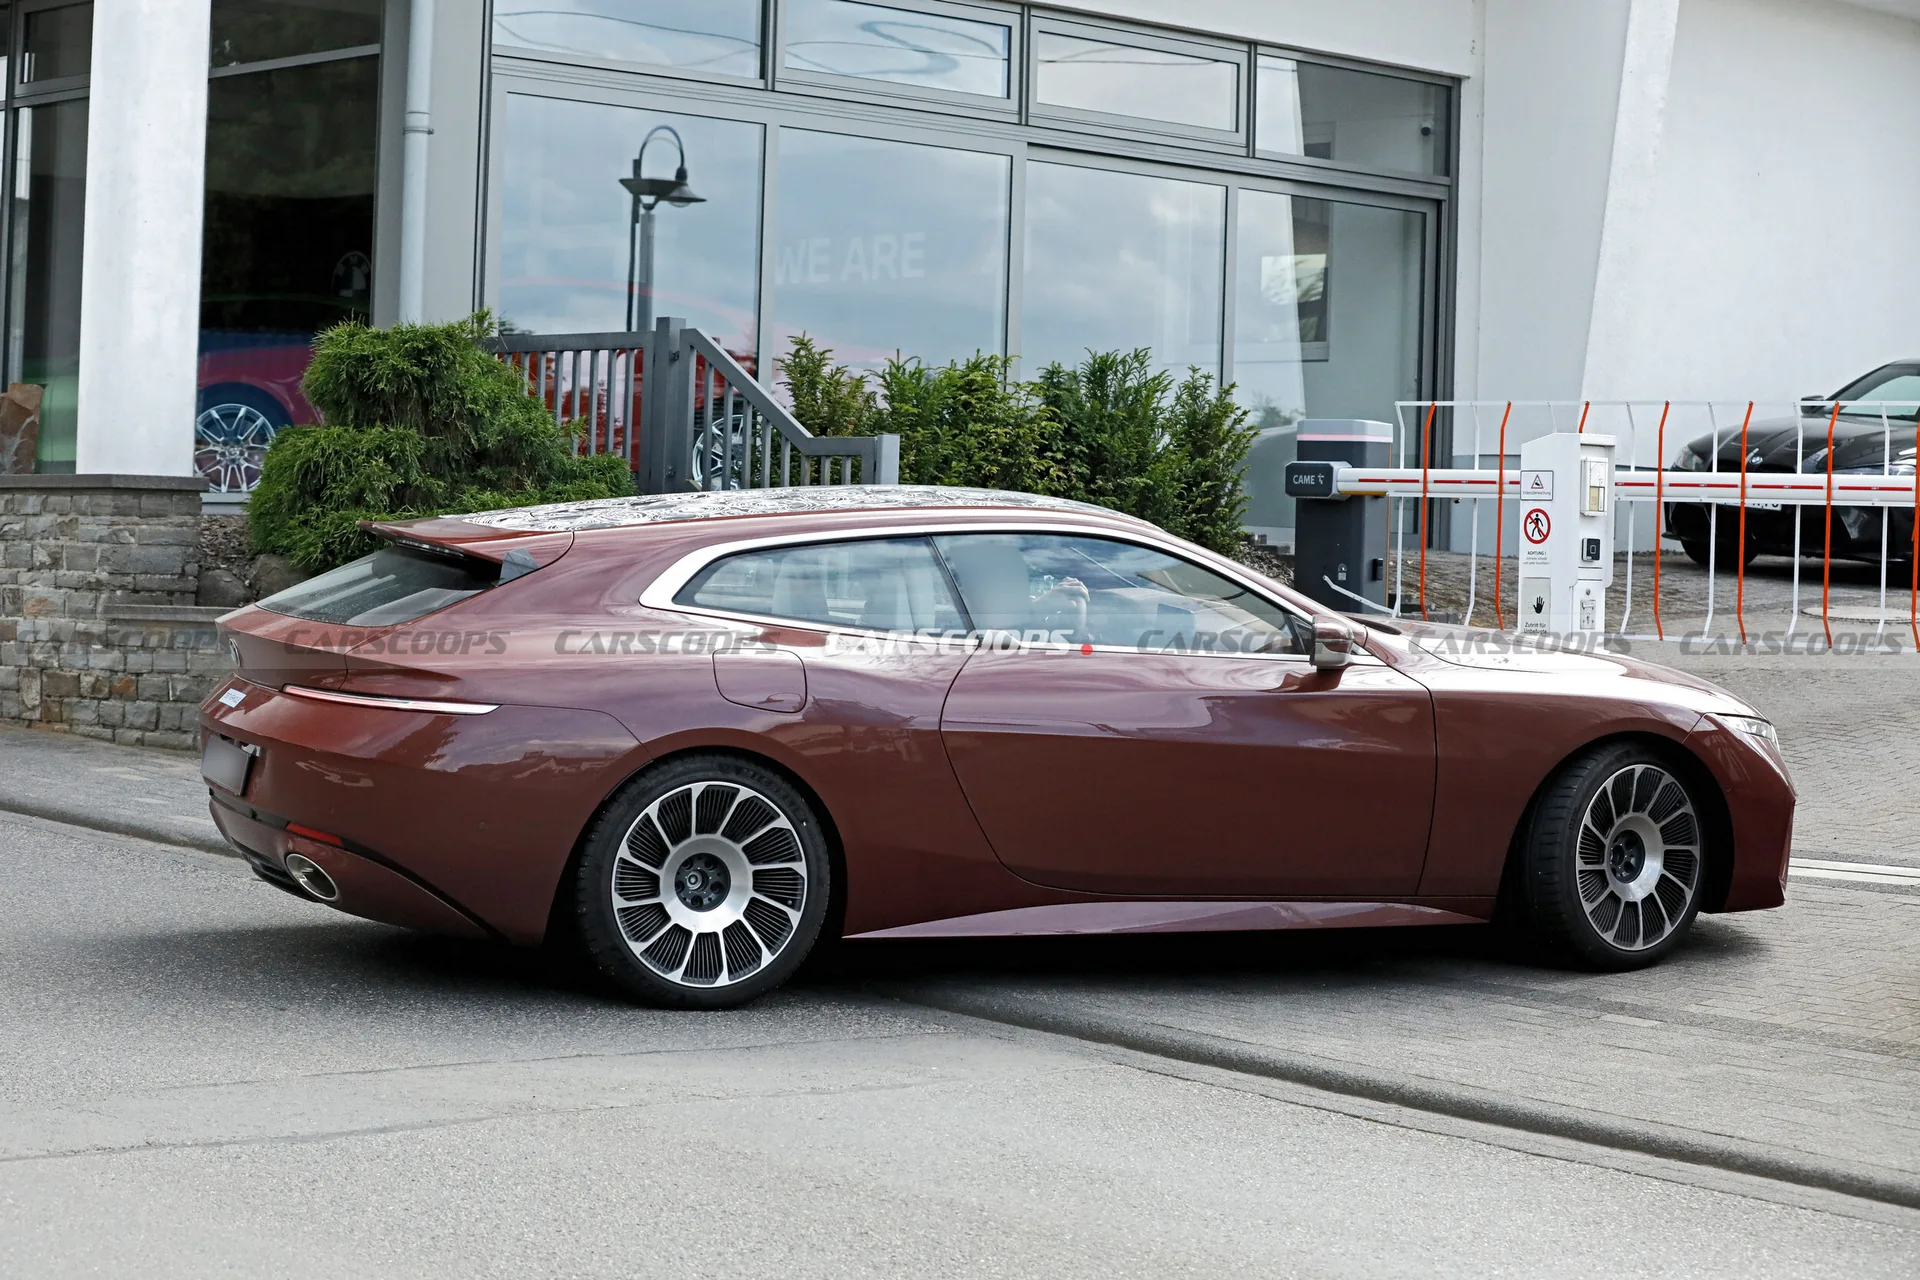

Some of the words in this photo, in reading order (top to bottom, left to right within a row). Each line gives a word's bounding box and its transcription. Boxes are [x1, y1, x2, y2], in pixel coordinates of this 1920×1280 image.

[774, 238, 831, 285] WE
[840, 232, 926, 282] ARE
[1292, 474, 1315, 485] CAME
